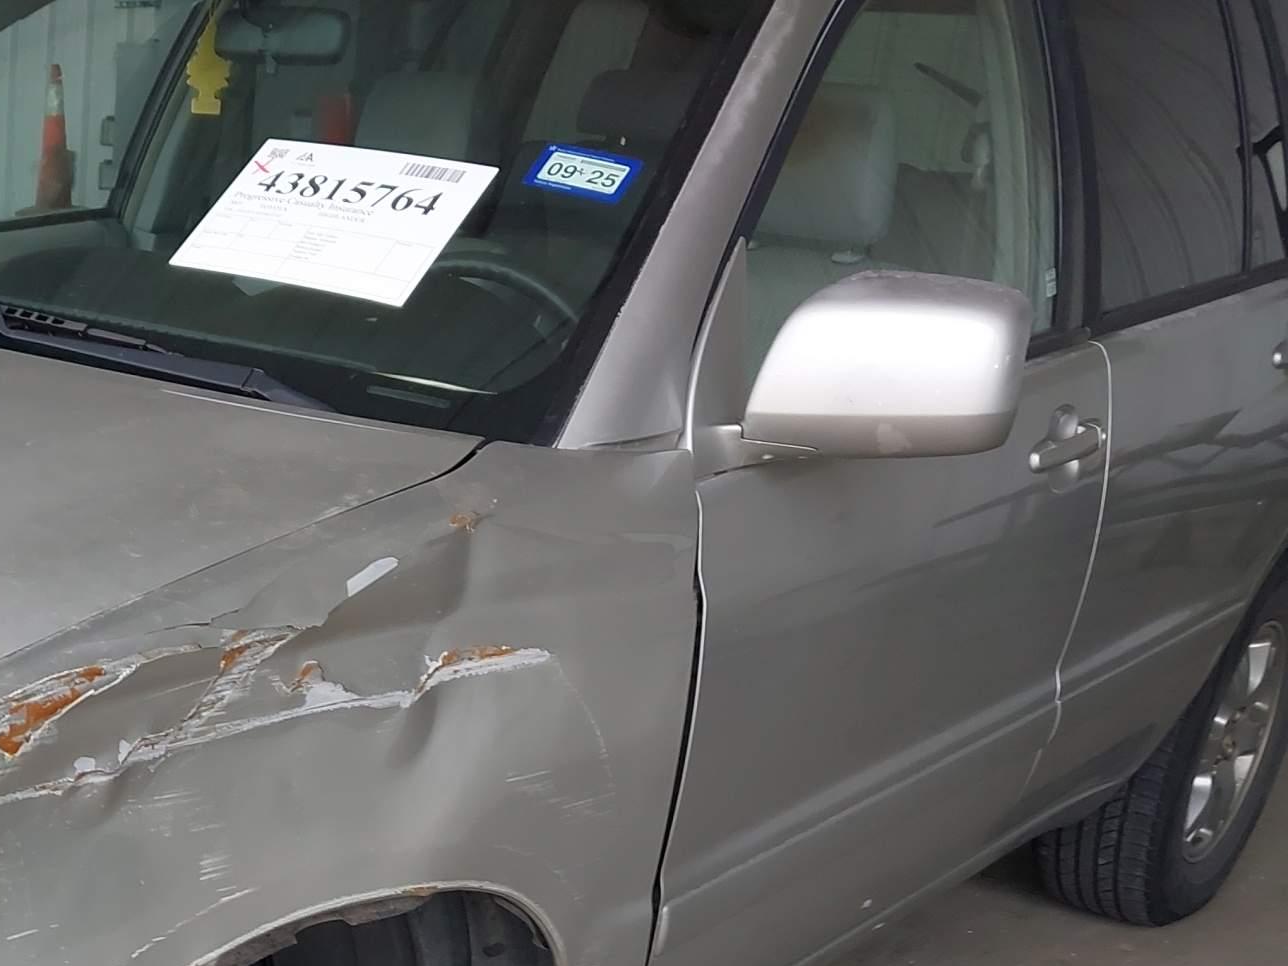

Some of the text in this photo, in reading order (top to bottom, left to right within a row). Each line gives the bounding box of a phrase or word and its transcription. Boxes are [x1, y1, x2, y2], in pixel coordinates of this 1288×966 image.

[258, 170, 444, 216] 43815764
[547, 162, 577, 179] 09
[585, 170, 620, 188] 25
